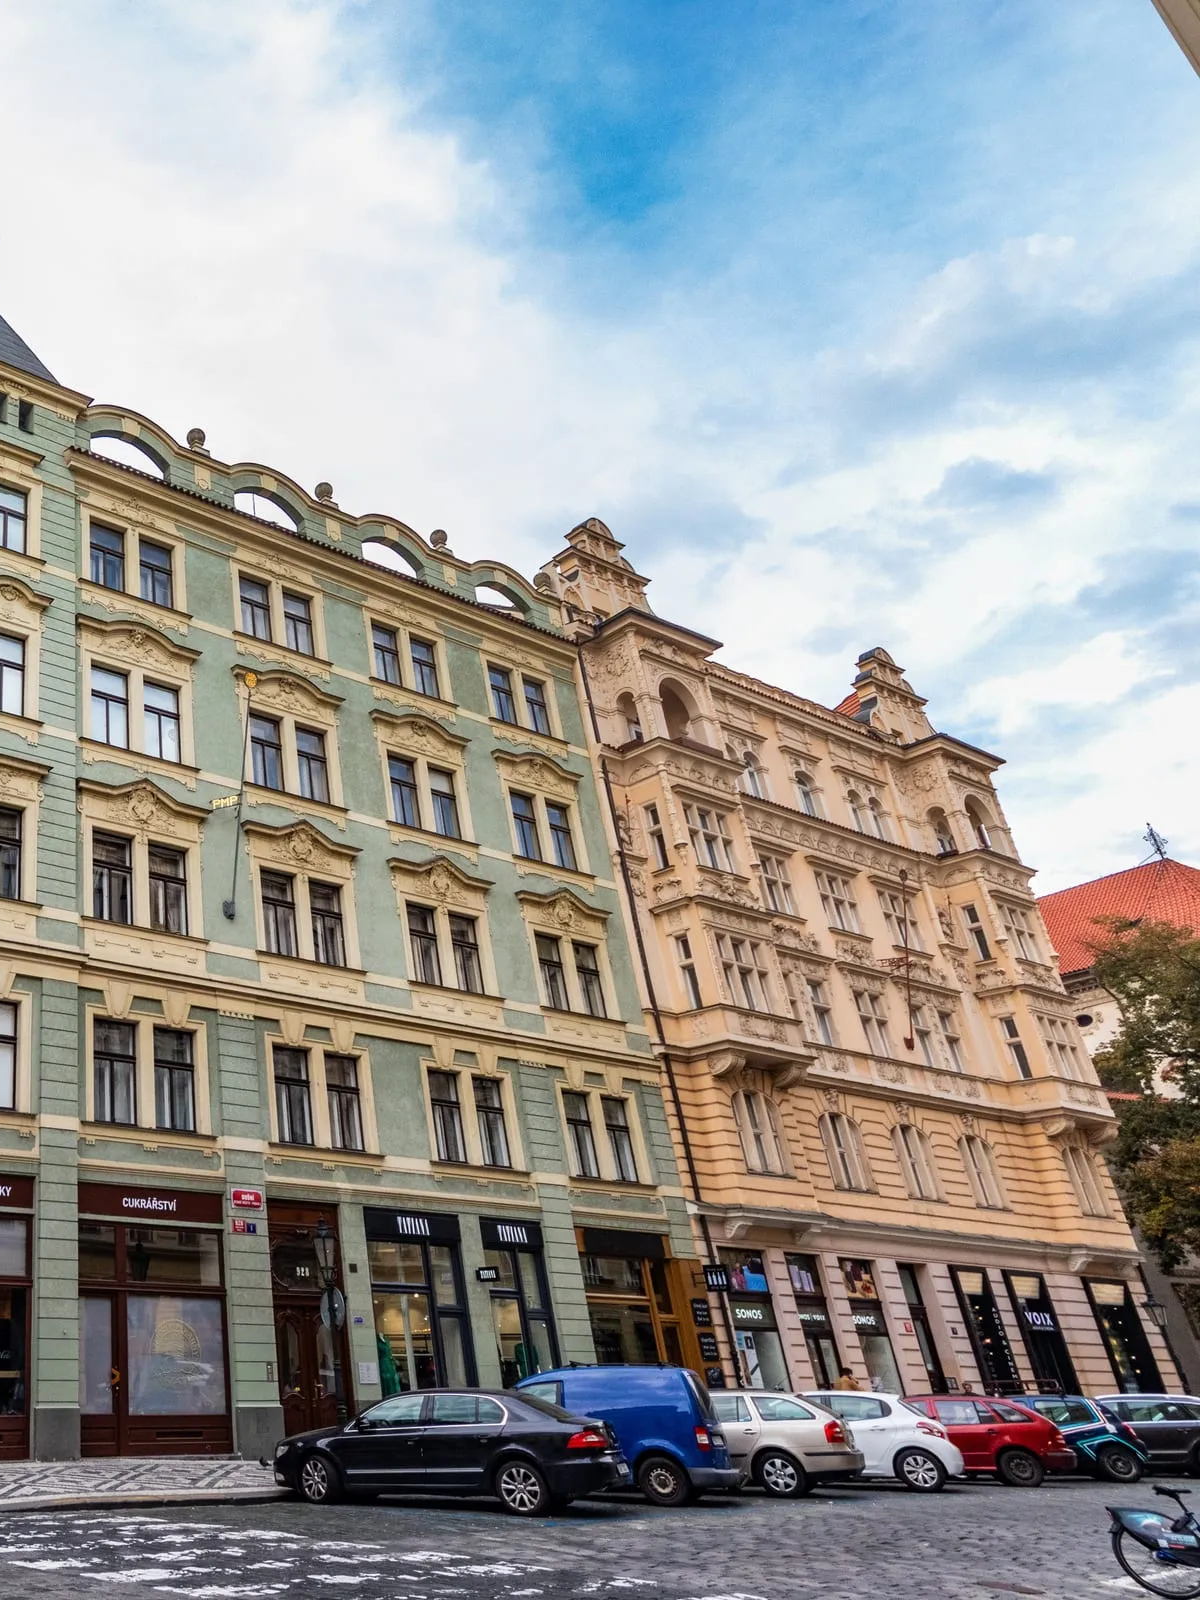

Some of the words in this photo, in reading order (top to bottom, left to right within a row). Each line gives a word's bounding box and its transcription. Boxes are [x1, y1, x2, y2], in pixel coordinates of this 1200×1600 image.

[122, 1197, 177, 1212] CUKRÁŘSTVÍ
[397, 1216, 430, 1236] TATIANA
[497, 1225, 528, 1243] TATIANA
[735, 1308, 763, 1320] SONOS
[852, 1315, 876, 1326] SONOS
[1024, 1311, 1054, 1326] VOIX
[992, 1307, 1005, 1337] AUDIO
[1004, 1349, 1019, 1384] CINEM
